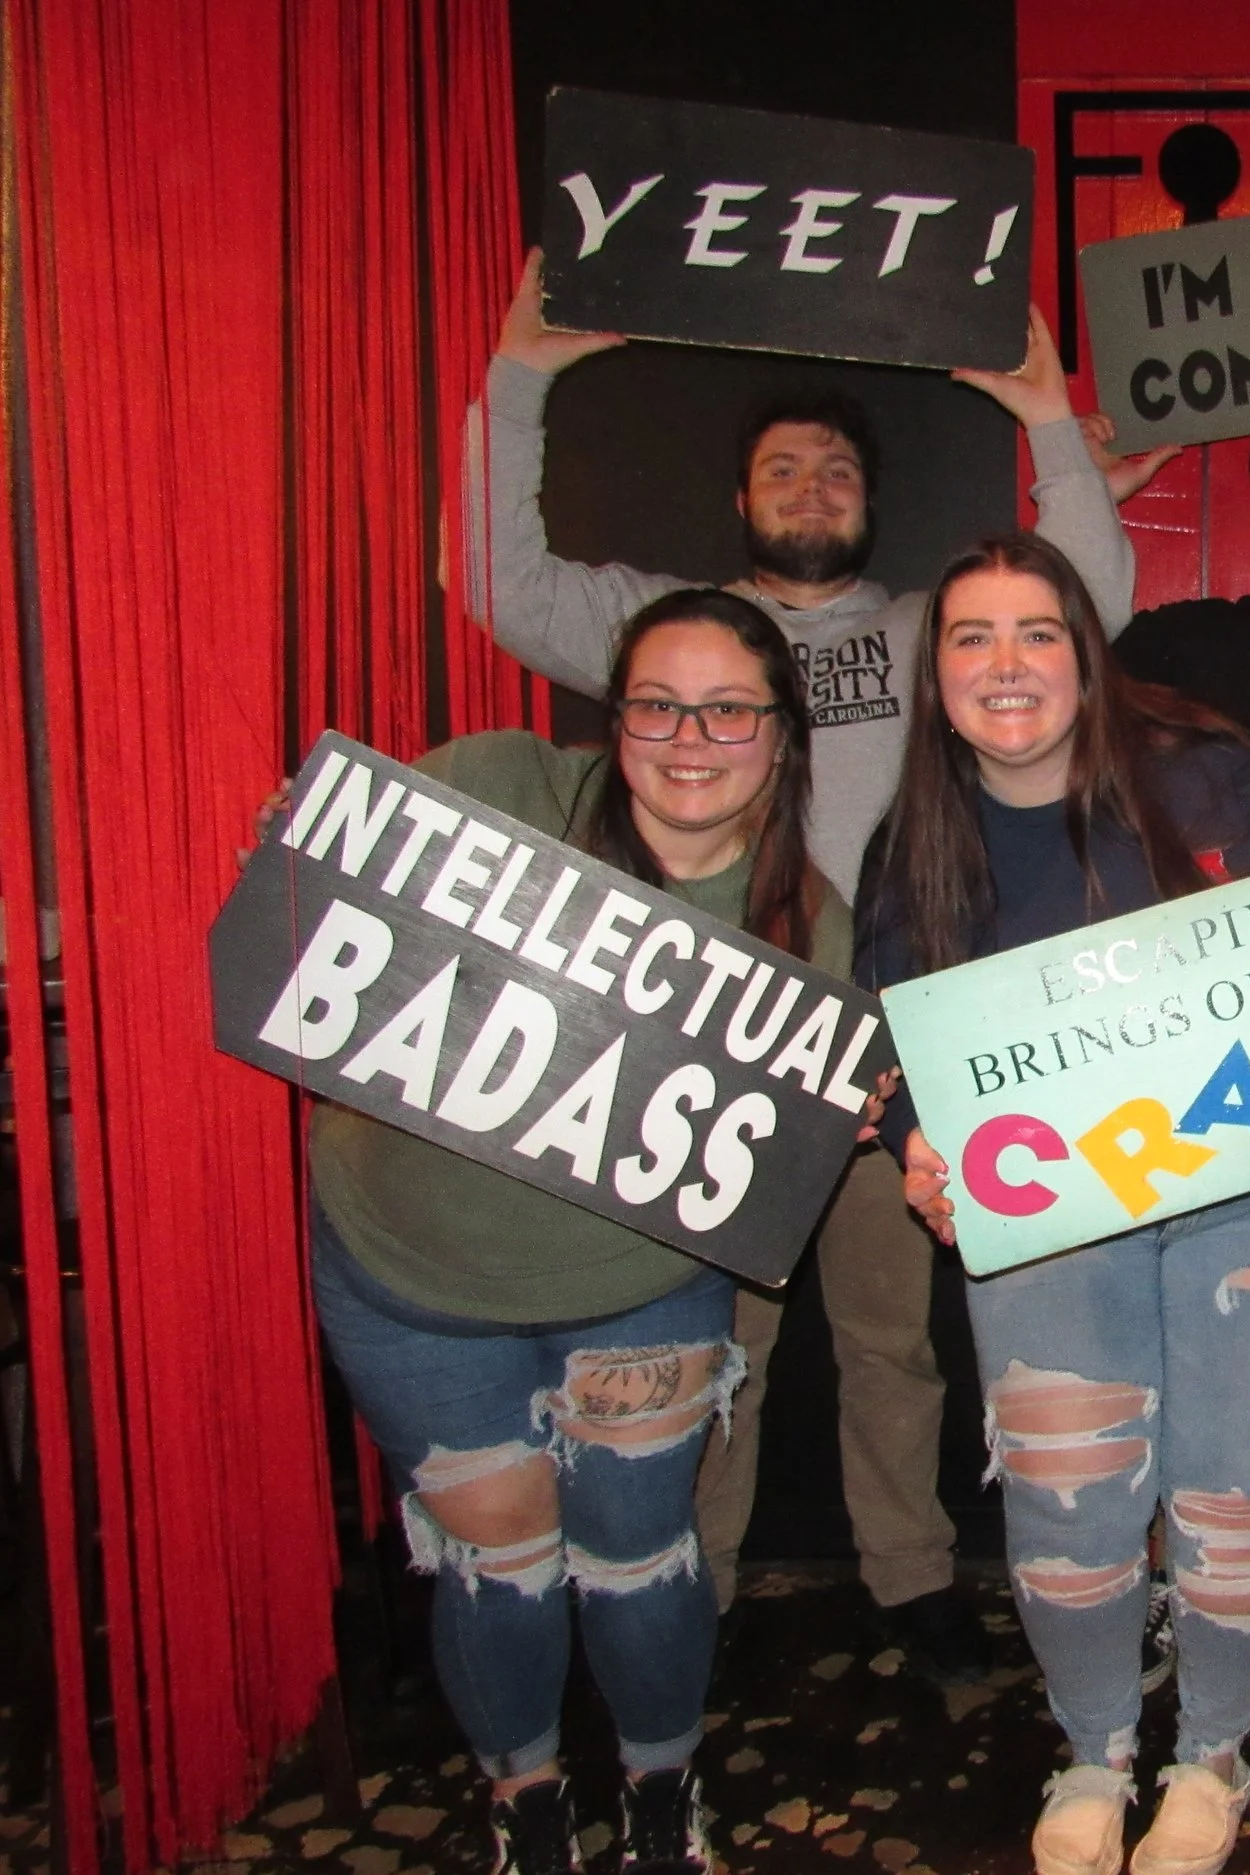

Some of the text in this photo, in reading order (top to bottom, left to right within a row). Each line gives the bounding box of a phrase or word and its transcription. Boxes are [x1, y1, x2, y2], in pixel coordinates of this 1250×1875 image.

[1143, 263, 1233, 330] I'M
[816, 702, 894, 724] CAROLINA
[281, 751, 879, 1113] INTELLECTUAL
[258, 899, 777, 1231] BADASS
[965, 994, 1192, 1097] BRINGS
